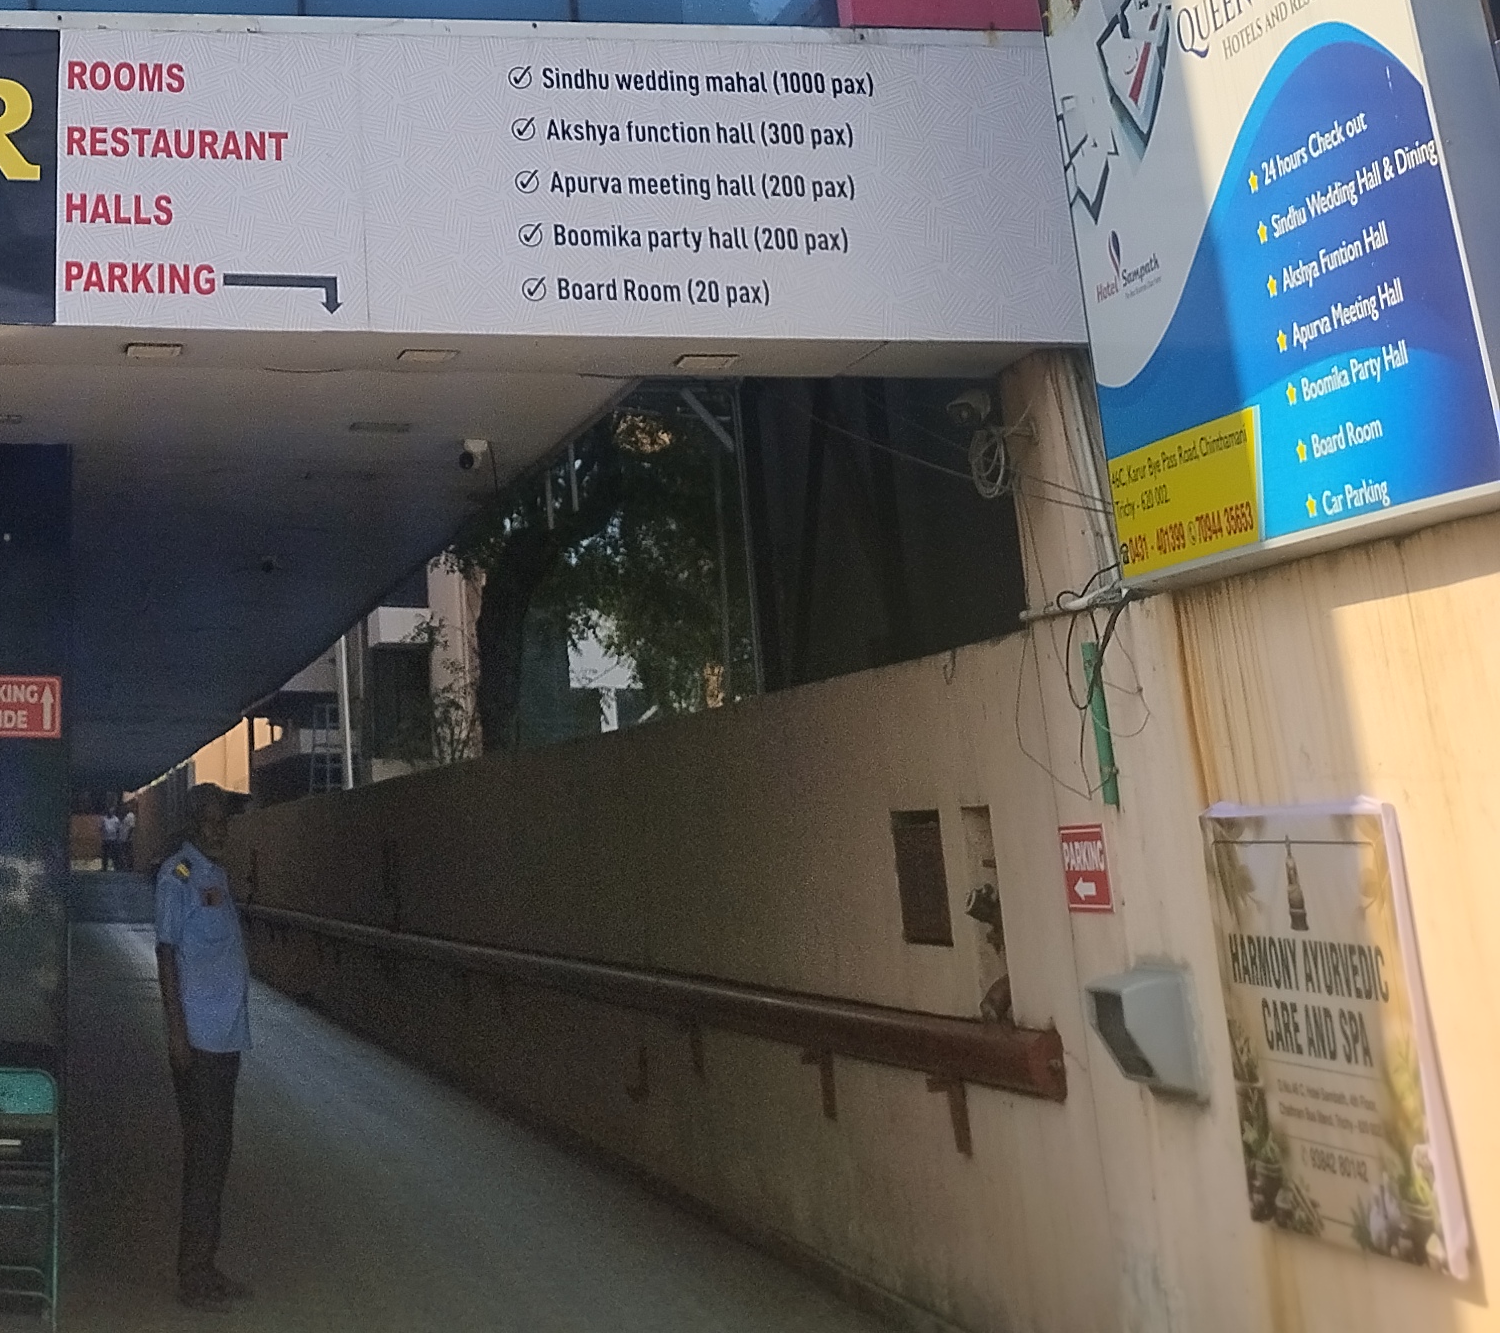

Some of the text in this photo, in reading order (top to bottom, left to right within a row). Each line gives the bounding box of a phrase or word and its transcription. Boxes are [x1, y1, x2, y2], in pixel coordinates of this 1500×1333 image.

[1222, 17, 1263, 60] HOTELS
[1265, 1, 1288, 33] AND
[66, 60, 185, 95] ROOMS
[542, 68, 874, 98] Sindhu wedding mahal (1000 pax)
[66, 127, 288, 162] RESTAURANT
[547, 119, 854, 149] Akshya function hall (300 pax)
[1261, 113, 1368, 185] 24 hours Check out
[551, 171, 856, 201] Apurva meeting hall (200 pax)
[1271, 139, 1438, 238] Sindhu Wedding Hall & Dining
[66, 193, 173, 226] HALLS
[553, 224, 849, 255] Boomika party hall (200 pax)
[1282, 220, 1389, 293] Akshya Funtion Hall
[65, 261, 217, 297] PARKING
[557, 278, 770, 308] Board Room (20 pax)
[1096, 275, 1119, 303] Hotel
[1121, 253, 1160, 287] Sampath
[1292, 277, 1404, 350] Apurva Meeting Hall
[1301, 339, 1409, 401] Boomika Party Hall
[1311, 419, 1383, 458] Board Room
[1322, 479, 1390, 515] Car Parking
[1062, 840, 1105, 871] PARKING
[1229, 934, 1389, 1003] HARMONY AYURVEDIC
[1262, 998, 1373, 1067] CARE AND SPA
